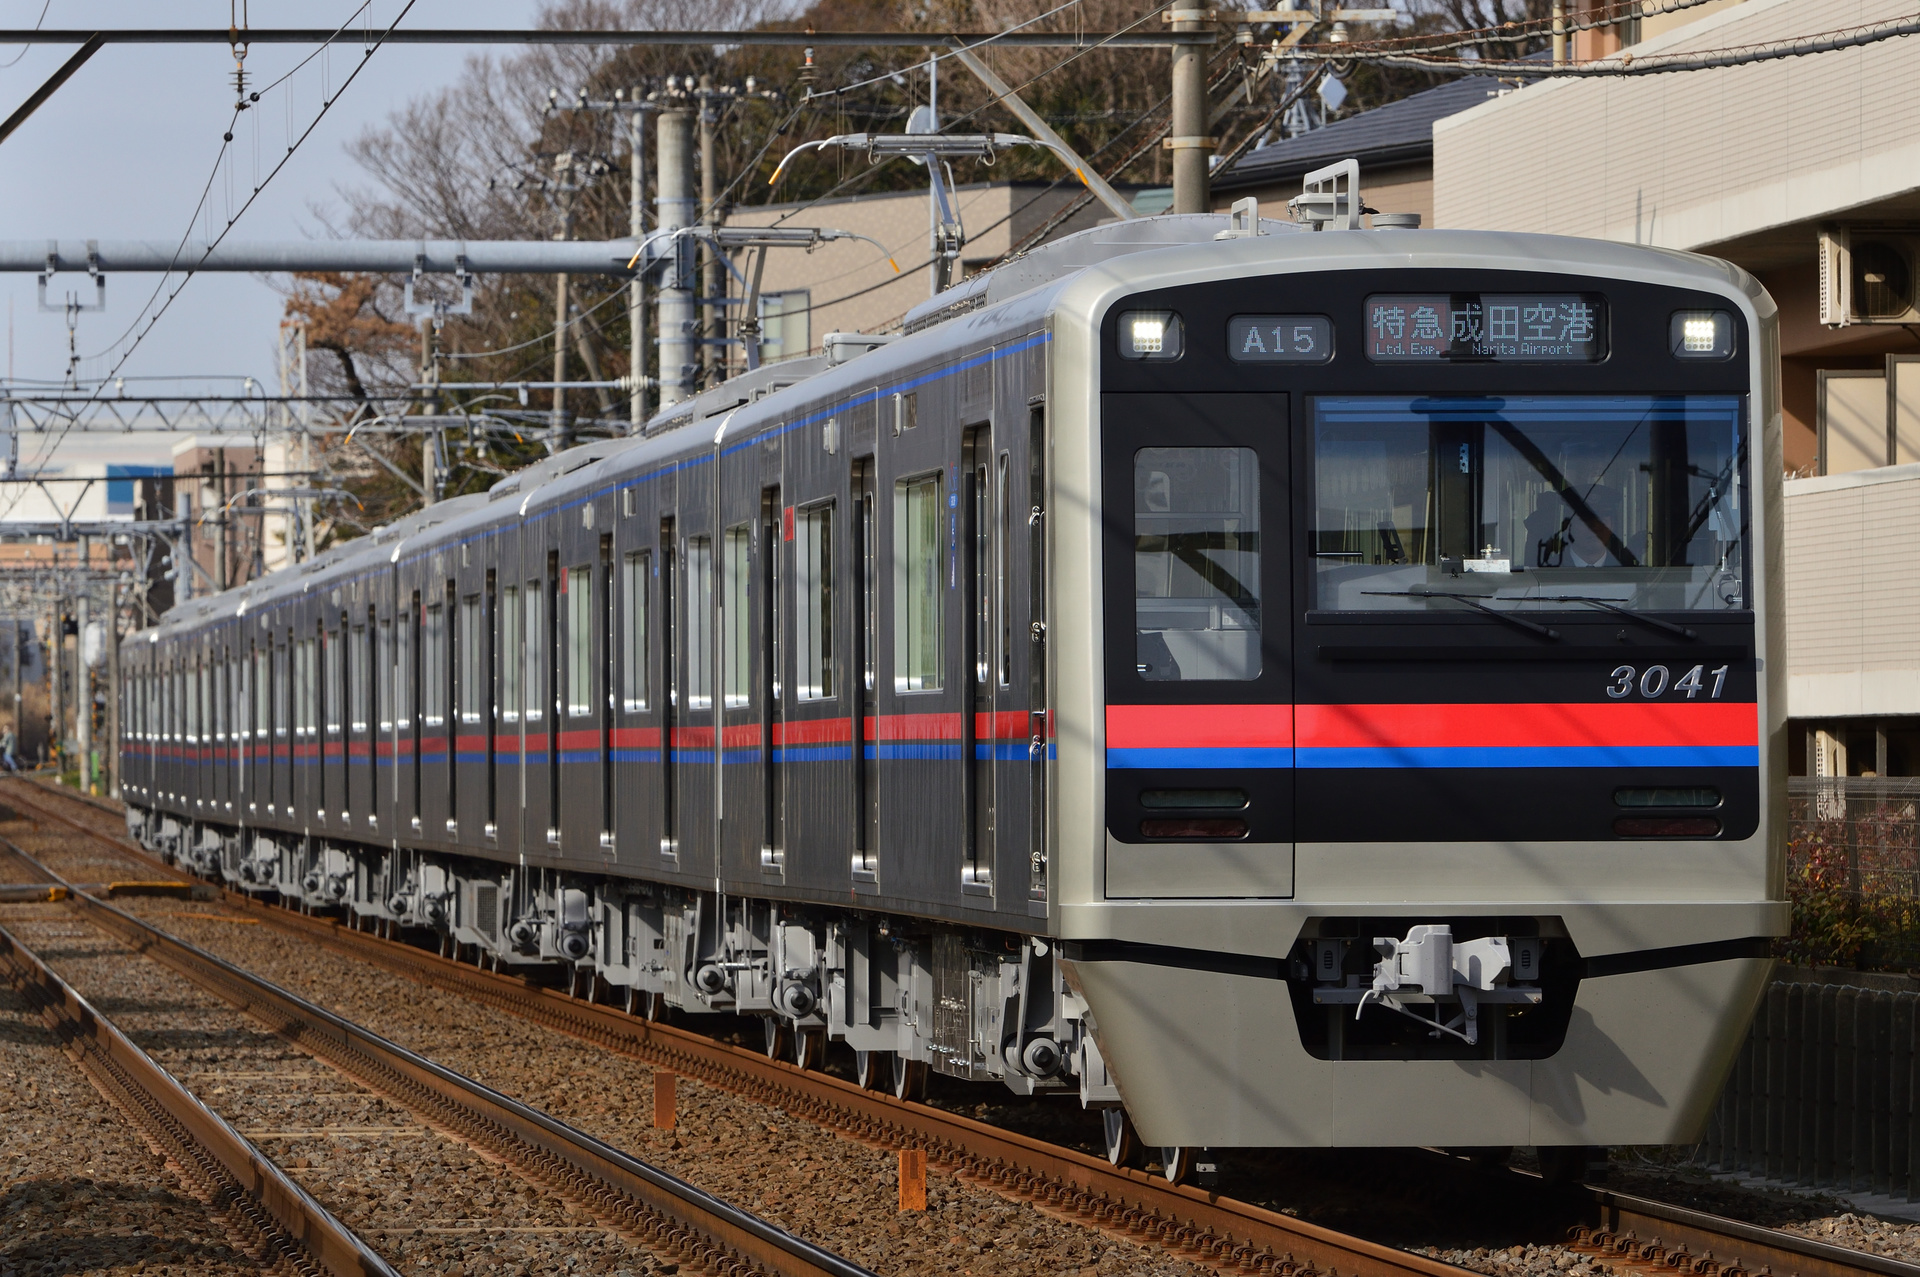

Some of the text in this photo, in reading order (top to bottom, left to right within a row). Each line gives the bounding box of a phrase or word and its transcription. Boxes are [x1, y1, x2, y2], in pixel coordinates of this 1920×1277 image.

[1373, 302, 1594, 342] 特急 成田空港
[1242, 326, 1315, 353] A15
[1376, 342, 1573, 355] Ltd. Exp. Narita Airport
[1606, 664, 1729, 699] 3041
